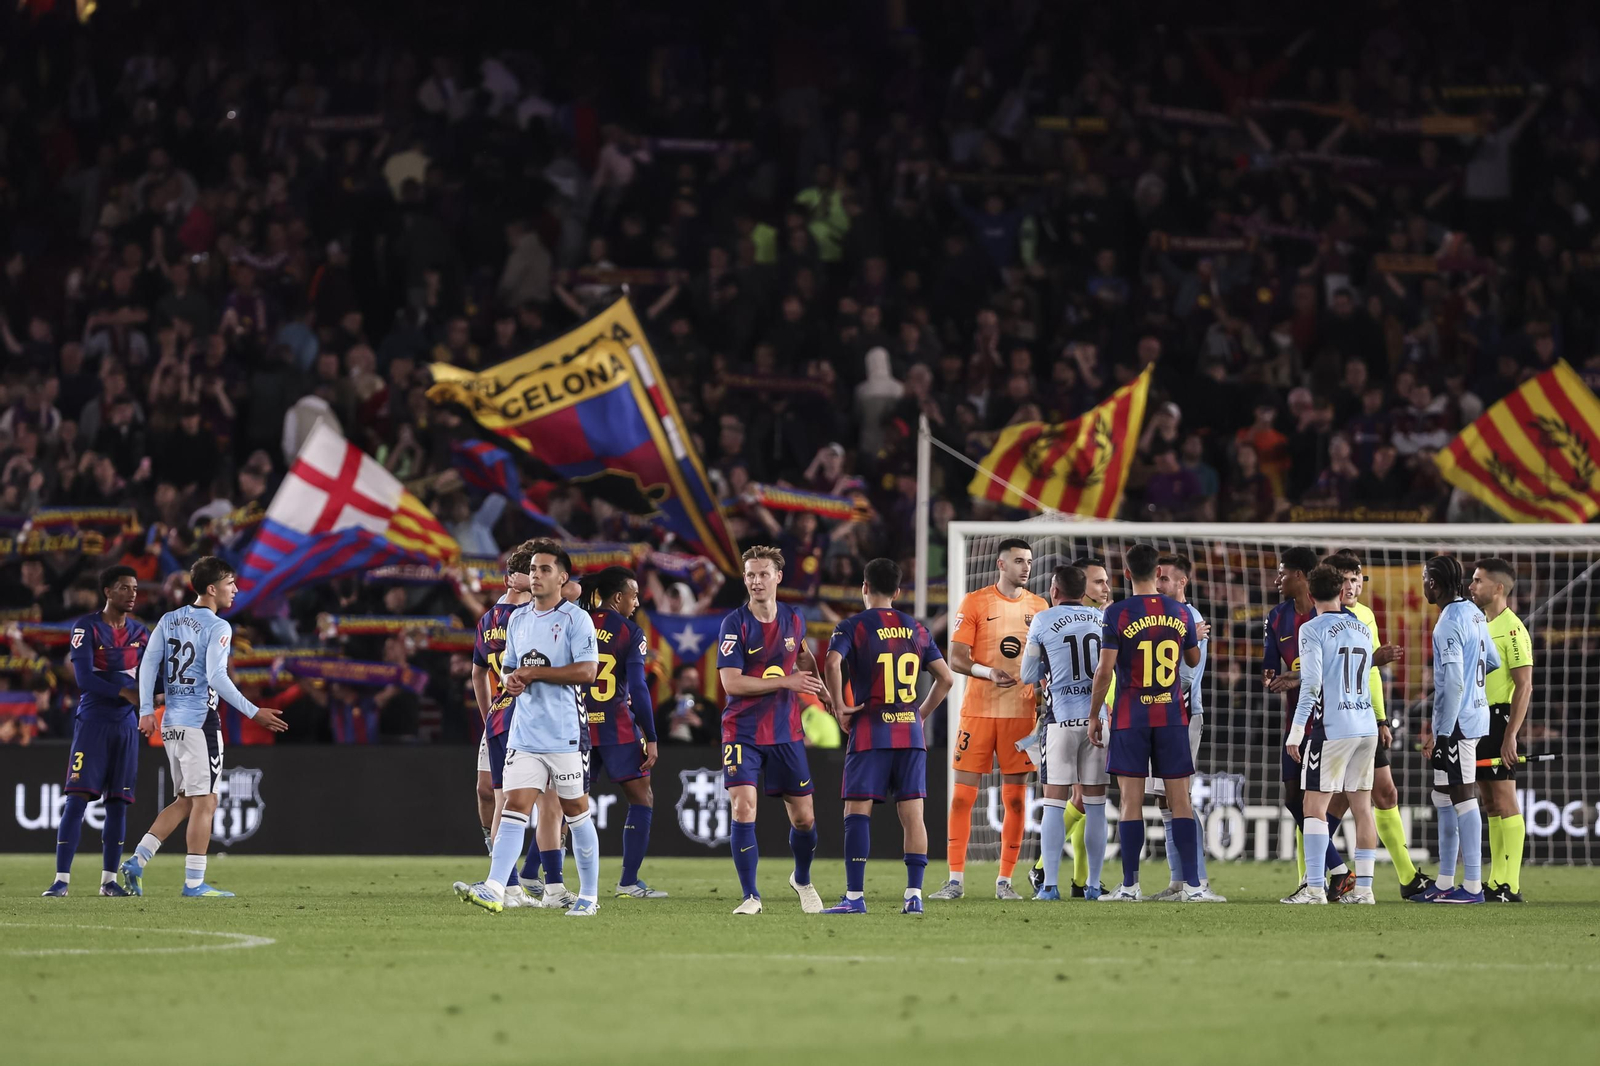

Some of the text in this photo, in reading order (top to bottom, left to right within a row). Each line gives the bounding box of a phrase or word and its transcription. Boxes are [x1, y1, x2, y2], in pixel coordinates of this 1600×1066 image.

[876, 627, 914, 640] ROONY
[1050, 615, 1073, 634] IAGO
[1123, 615, 1157, 639] GERARD
[1328, 621, 1370, 640] JAVI RUEDA
[167, 637, 196, 685] 32
[523, 657, 546, 665] Estrella
[1062, 632, 1100, 681] 10
[1137, 639, 1179, 688] 18
[1476, 639, 1486, 687] 6
[877, 652, 920, 704] 19
[1338, 646, 1368, 694] 17
[73, 751, 84, 771] 3
[723, 744, 743, 765] 21
